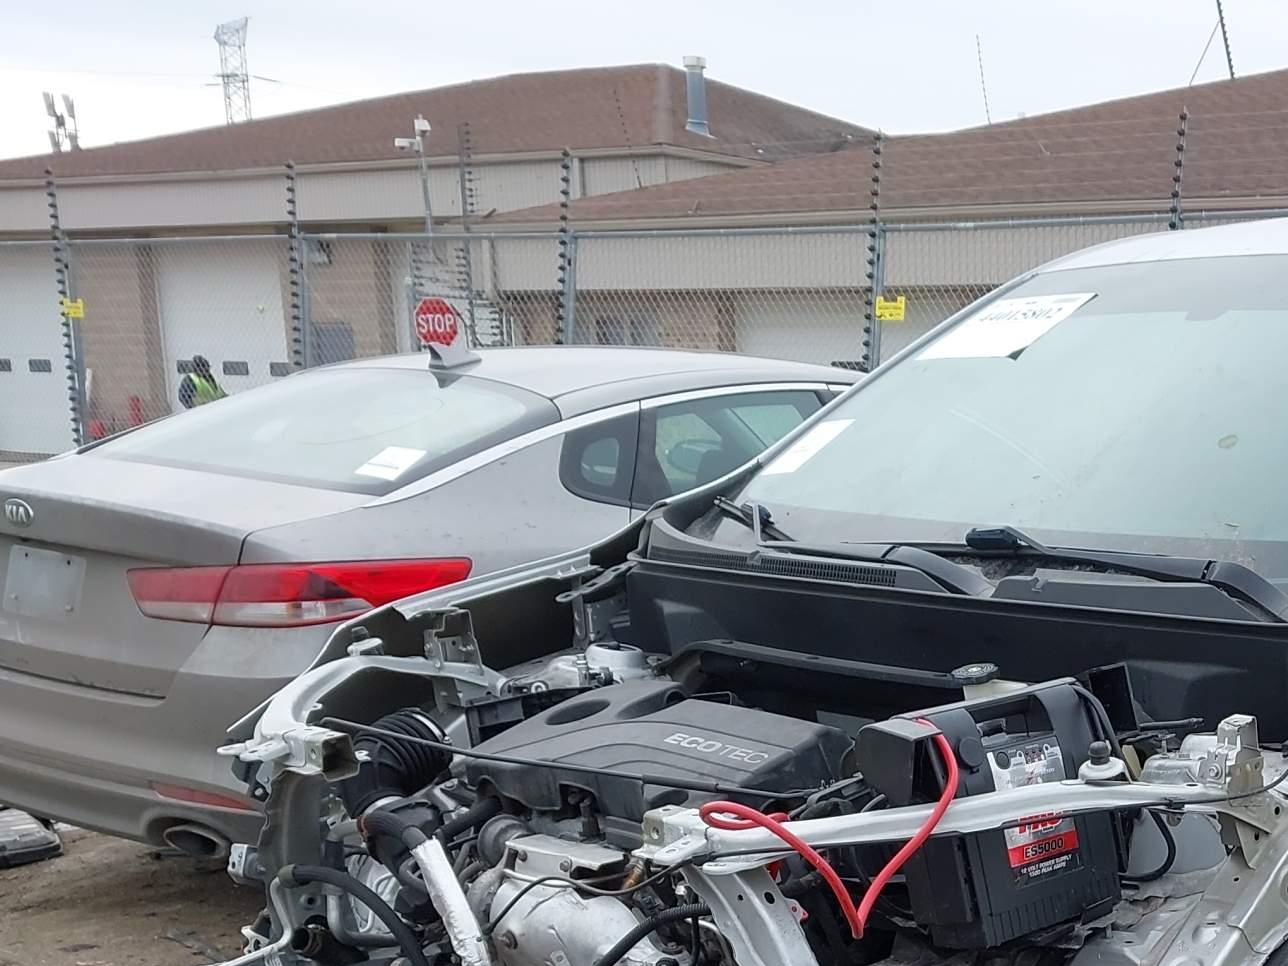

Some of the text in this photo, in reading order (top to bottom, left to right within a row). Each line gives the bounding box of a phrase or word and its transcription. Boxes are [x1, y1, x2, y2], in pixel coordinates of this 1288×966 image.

[418, 313, 454, 333] STOP
[5, 503, 28, 523] KIA
[663, 732, 769, 764] ECOTEC
[1024, 837, 1064, 859] ES5000
